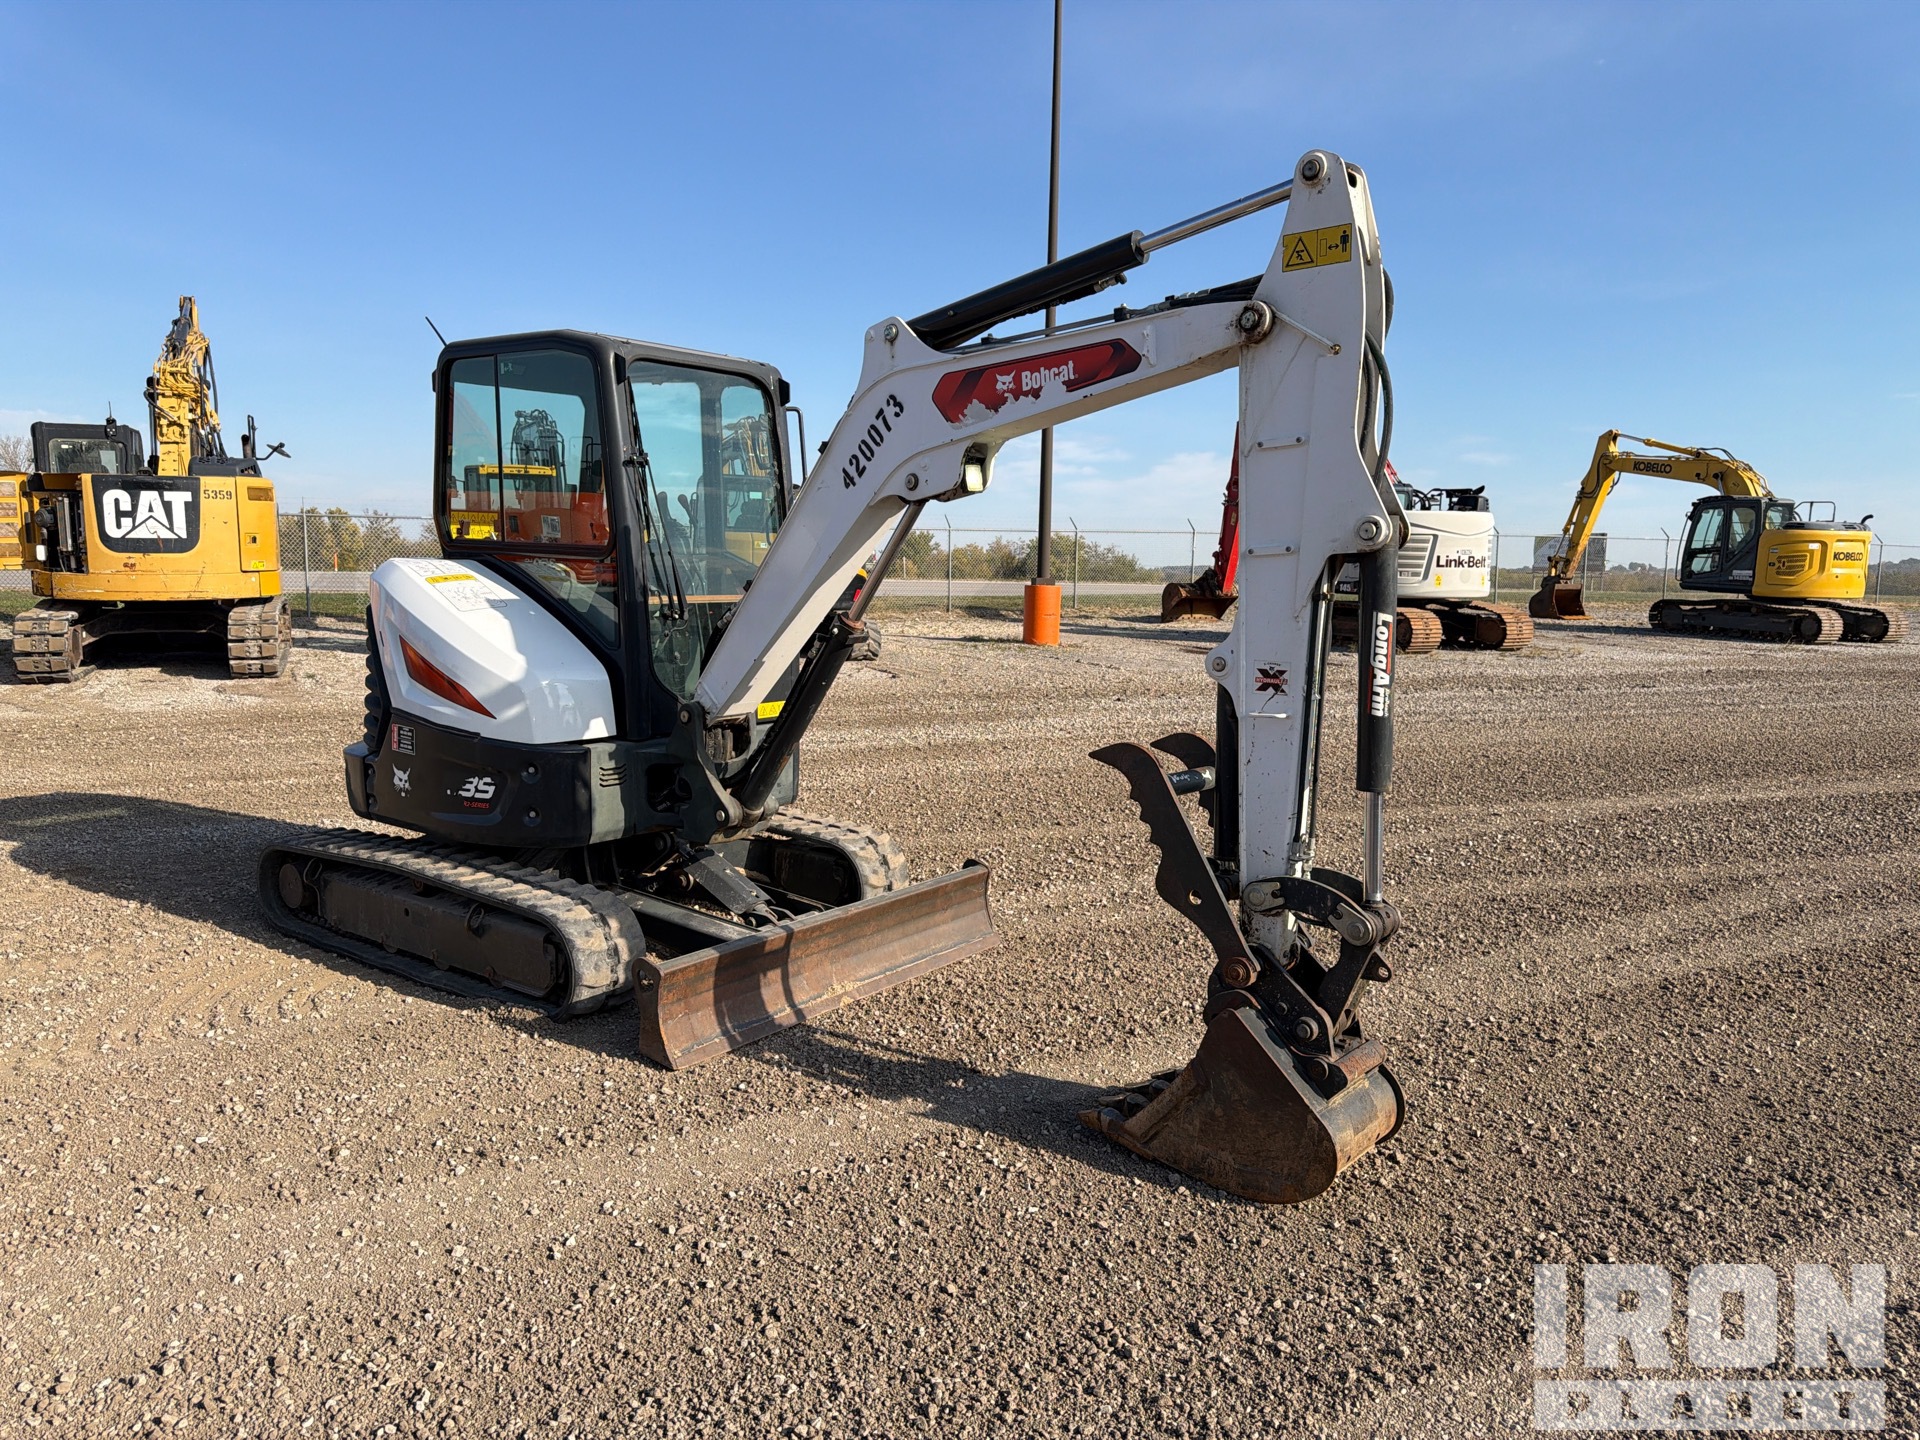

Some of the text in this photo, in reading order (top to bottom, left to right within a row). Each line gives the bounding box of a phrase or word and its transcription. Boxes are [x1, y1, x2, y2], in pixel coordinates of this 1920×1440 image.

[1021, 360, 1075, 391] Bobcat
[842, 394, 904, 489] 420073
[1632, 460, 1673, 474] KOBELCO
[203, 489, 233, 500] 5359
[102, 489, 192, 539] CAT
[1435, 555, 1487, 568] Link-Belt
[1833, 551, 1864, 561] KOBELCO
[1371, 612, 1393, 717] LongArm
